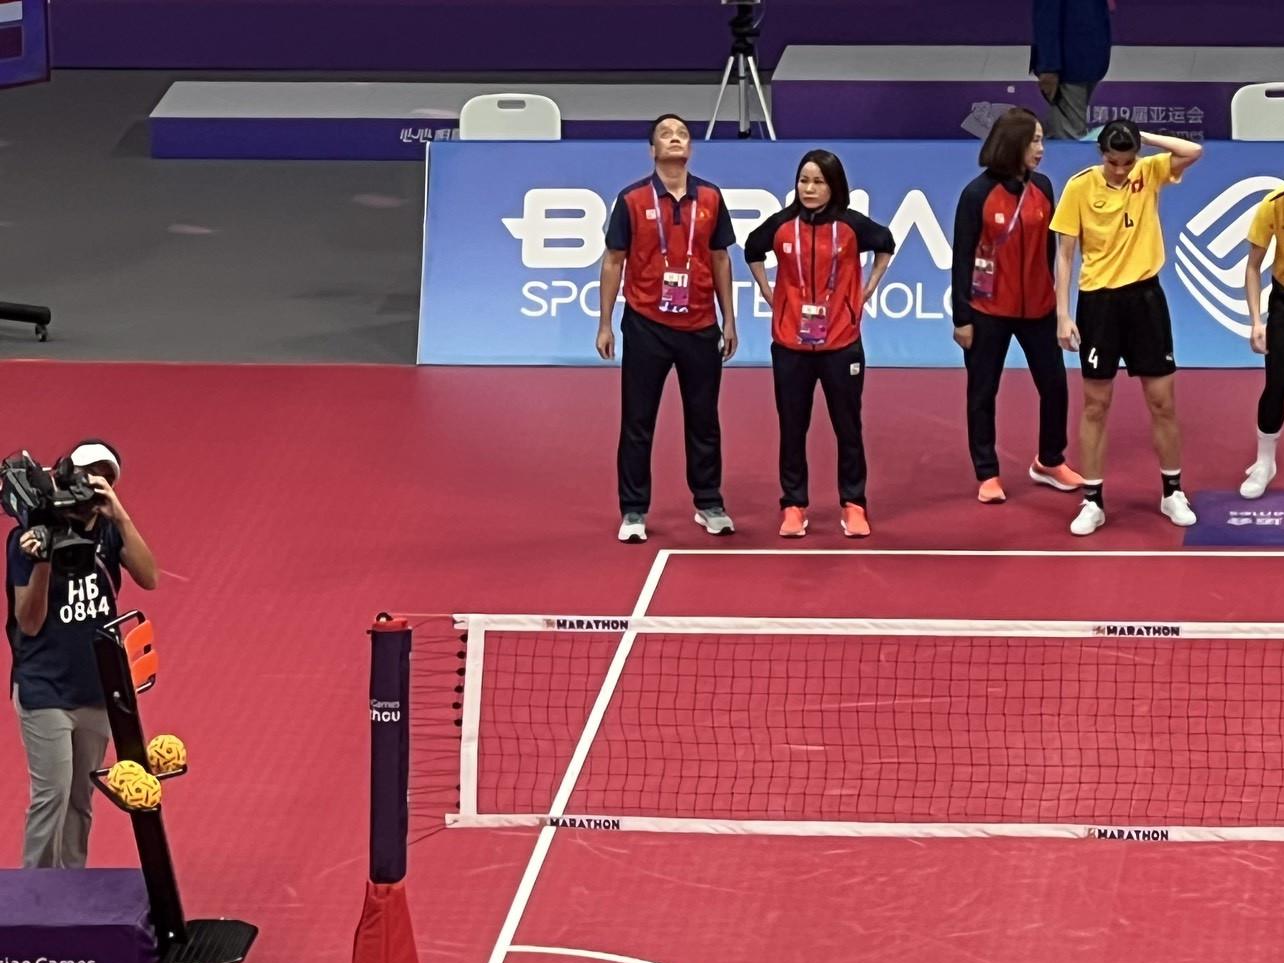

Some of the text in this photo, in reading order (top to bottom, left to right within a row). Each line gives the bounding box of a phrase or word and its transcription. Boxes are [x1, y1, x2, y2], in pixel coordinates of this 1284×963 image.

[1088, 347, 1099, 370] 4
[59, 596, 110, 624] 0844
[556, 618, 629, 631] MARATHON
[1106, 625, 1180, 637] MARATHON
[549, 818, 620, 831] MARATHON
[1097, 828, 1169, 841] MARATHON
